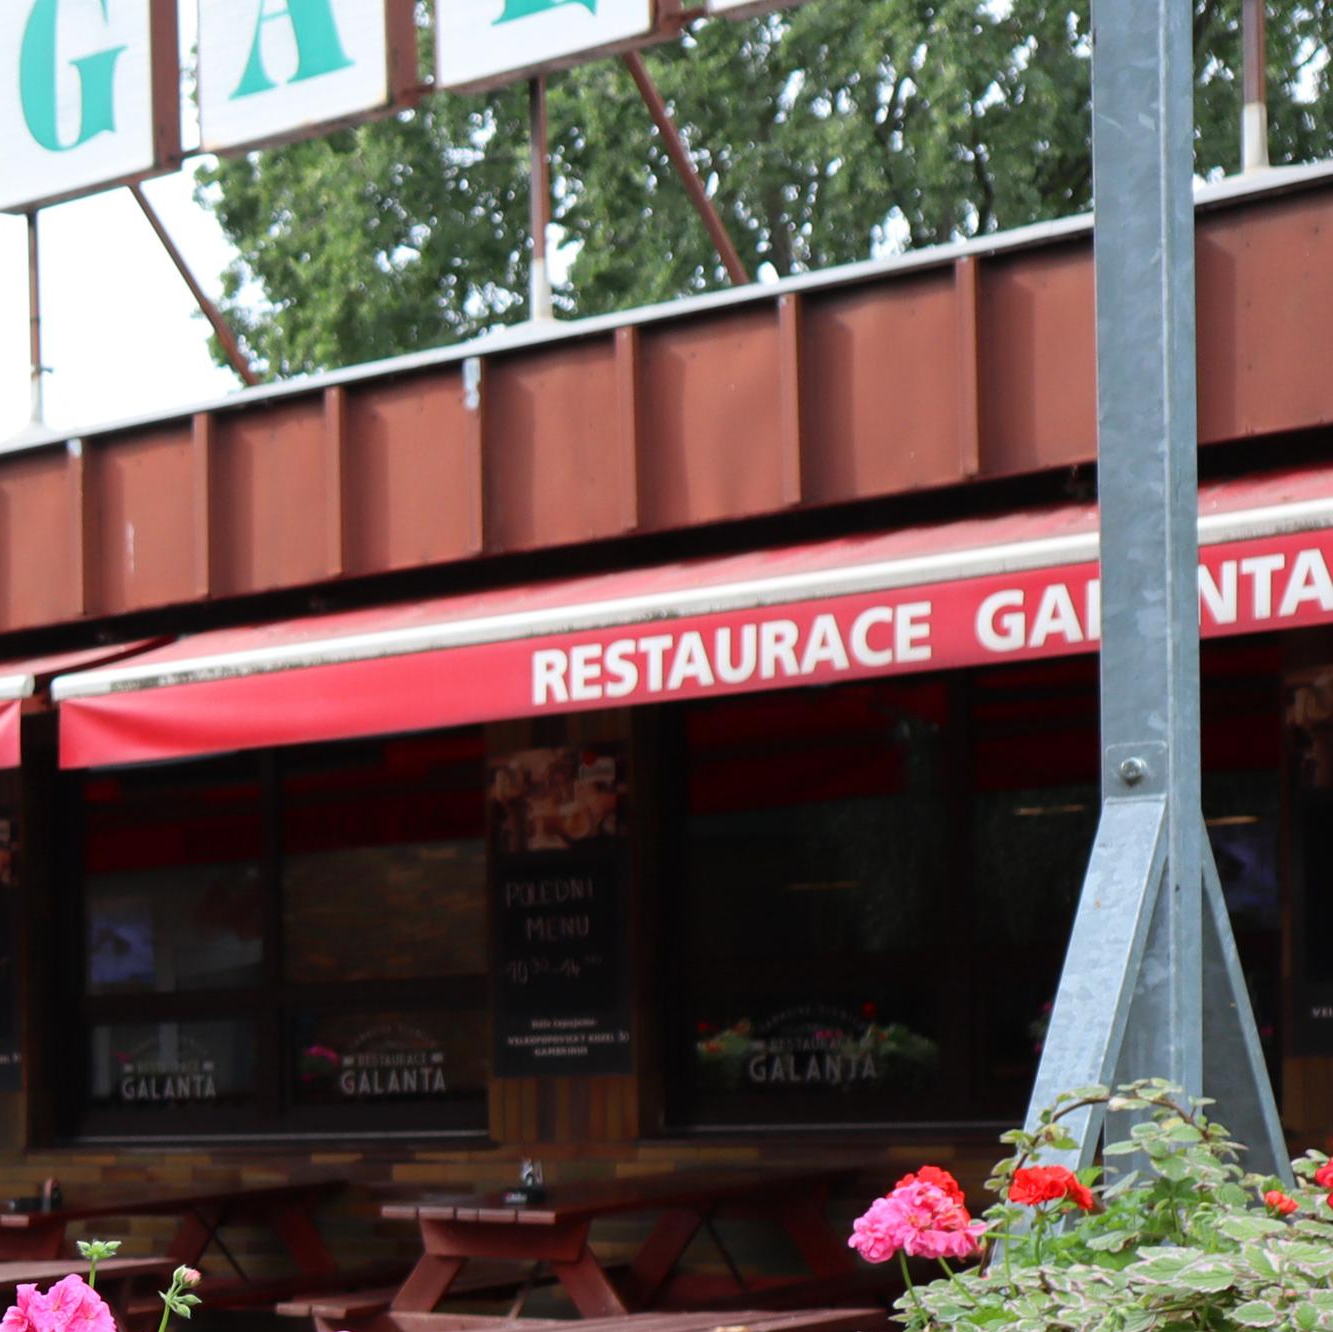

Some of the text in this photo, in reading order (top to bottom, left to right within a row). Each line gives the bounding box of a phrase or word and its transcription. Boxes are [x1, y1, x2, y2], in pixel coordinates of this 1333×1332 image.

[532, 599, 934, 707] RESTAURACE
[340, 1067, 446, 1096] GALANTA
[748, 1053, 879, 1084] GALANTA
[121, 1075, 217, 1102] GALANTA
